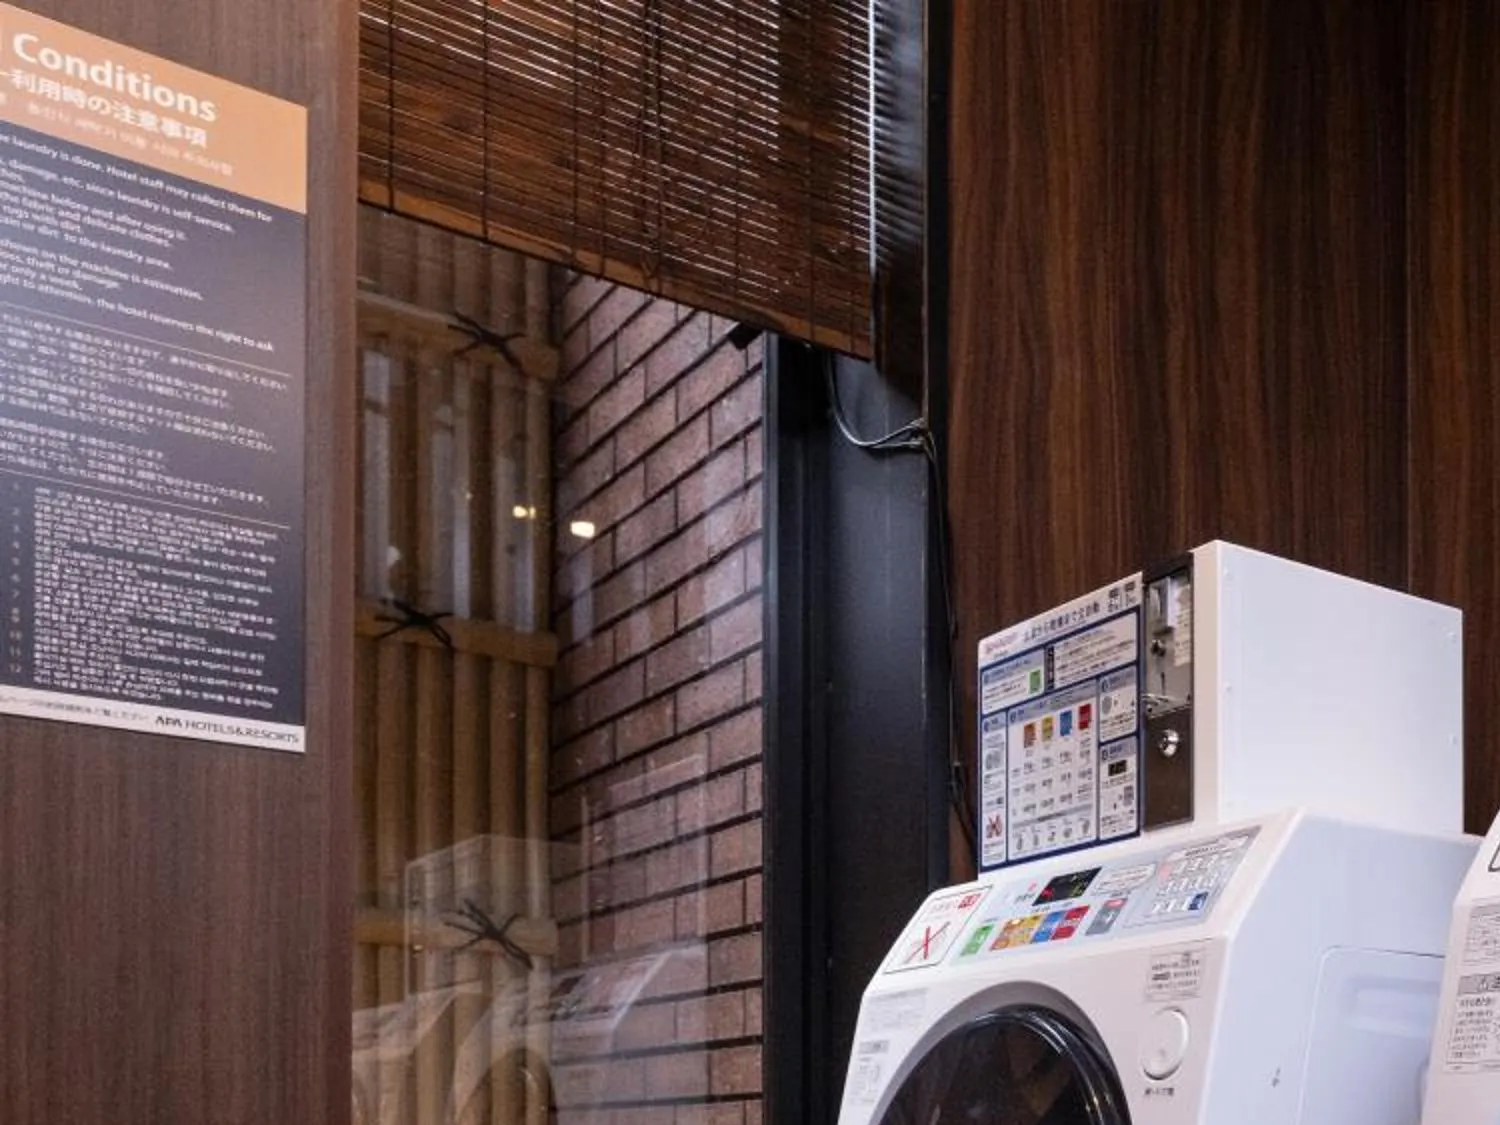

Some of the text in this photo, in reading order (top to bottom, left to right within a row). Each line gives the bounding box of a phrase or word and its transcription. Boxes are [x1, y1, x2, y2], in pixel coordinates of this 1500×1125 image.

[13, 33, 218, 122] Conditions
[12, 135, 272, 223] laundry is done. Hotel staff may collect them for
[51, 193, 89, 212] before
[91, 208, 114, 220] and
[86, 183, 115, 197] since
[117, 190, 160, 212] laundry
[58, 210, 81, 222] and
[79, 237, 99, 249] the
[100, 243, 143, 262] laundry
[59, 255, 80, 267] the
[81, 260, 130, 280] machine
[97, 298, 117, 311] the
[117, 304, 147, 320] hotel
[149, 313, 194, 331] reserves
[195, 325, 214, 337] the
[215, 330, 243, 345] right
[243, 337, 256, 347] to
[256, 341, 274, 353] ask
